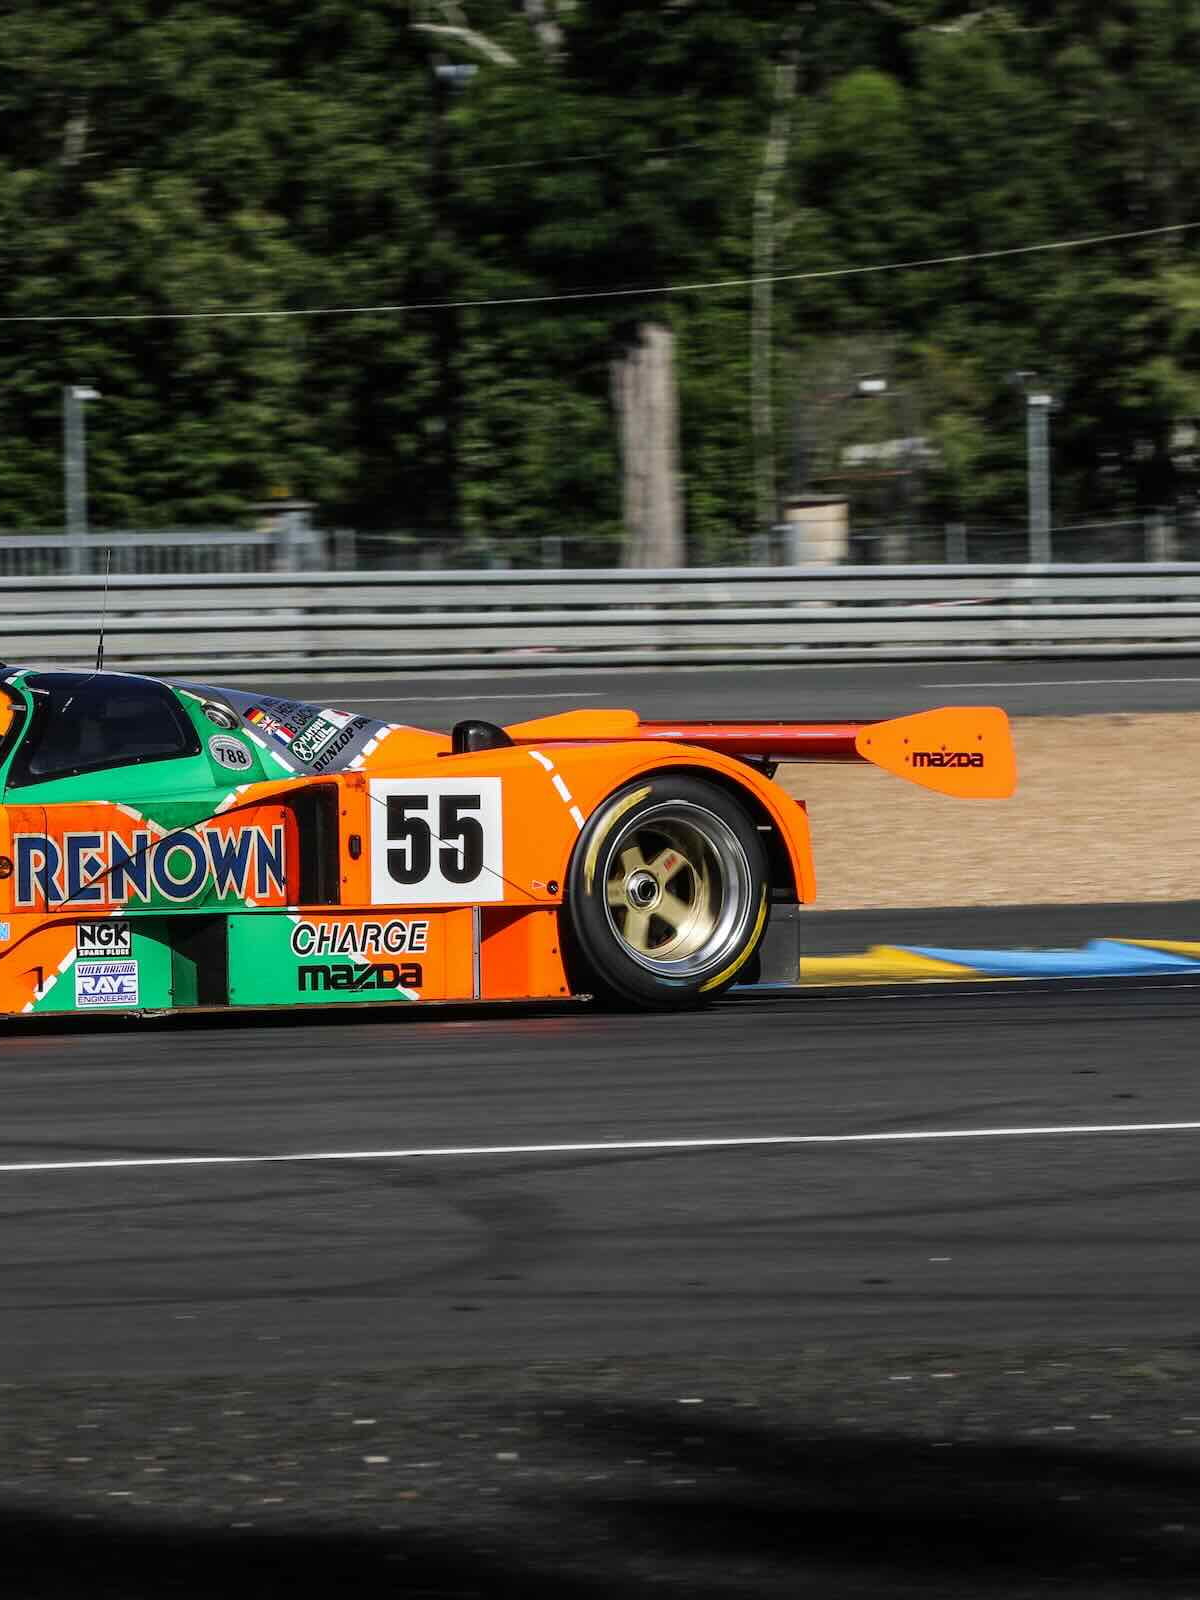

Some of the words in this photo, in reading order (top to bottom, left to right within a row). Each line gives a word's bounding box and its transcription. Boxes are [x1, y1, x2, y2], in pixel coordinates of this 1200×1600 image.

[216, 747, 247, 764] 788
[313, 726, 355, 772] DUNLOP
[912, 752, 985, 768] mazda
[387, 795, 483, 884] 55
[13, 826, 285, 906] RENOWN
[80, 924, 129, 947] NGK
[291, 921, 428, 954] CHARGE
[78, 975, 136, 994] RAYS
[298, 963, 422, 992] mazda
[78, 994, 136, 1003] ENGINEERING
